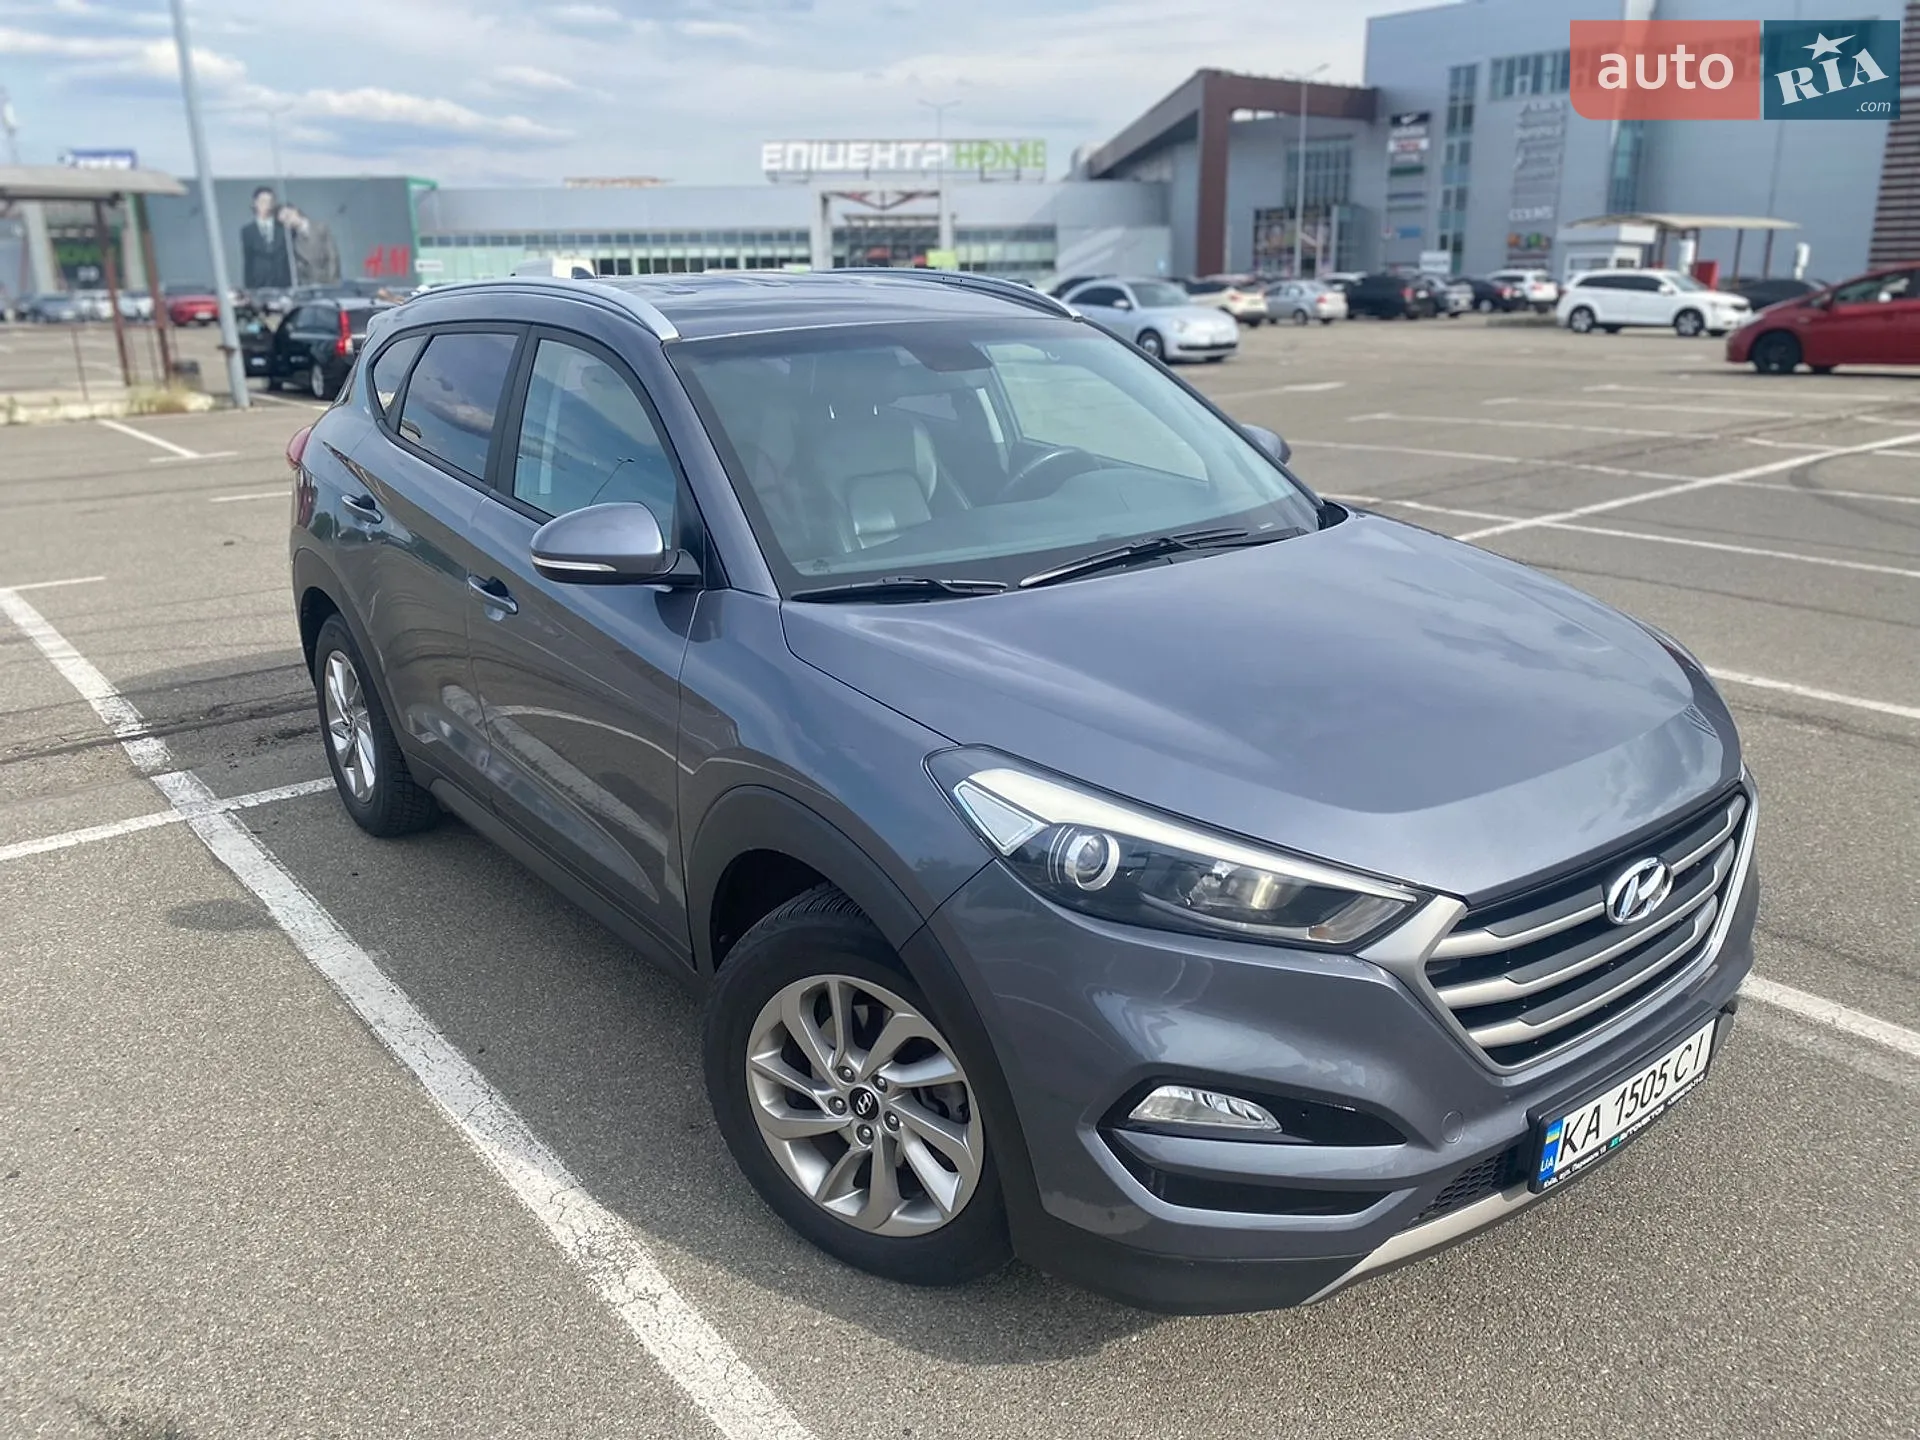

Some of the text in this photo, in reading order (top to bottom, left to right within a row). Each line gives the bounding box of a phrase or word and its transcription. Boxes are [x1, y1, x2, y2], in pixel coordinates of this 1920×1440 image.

[761, 138, 1047, 170] ЕПІЦЕНТР HOME
[1558, 1103, 1601, 1163] KA
[1613, 1058, 1671, 1127] 1505
